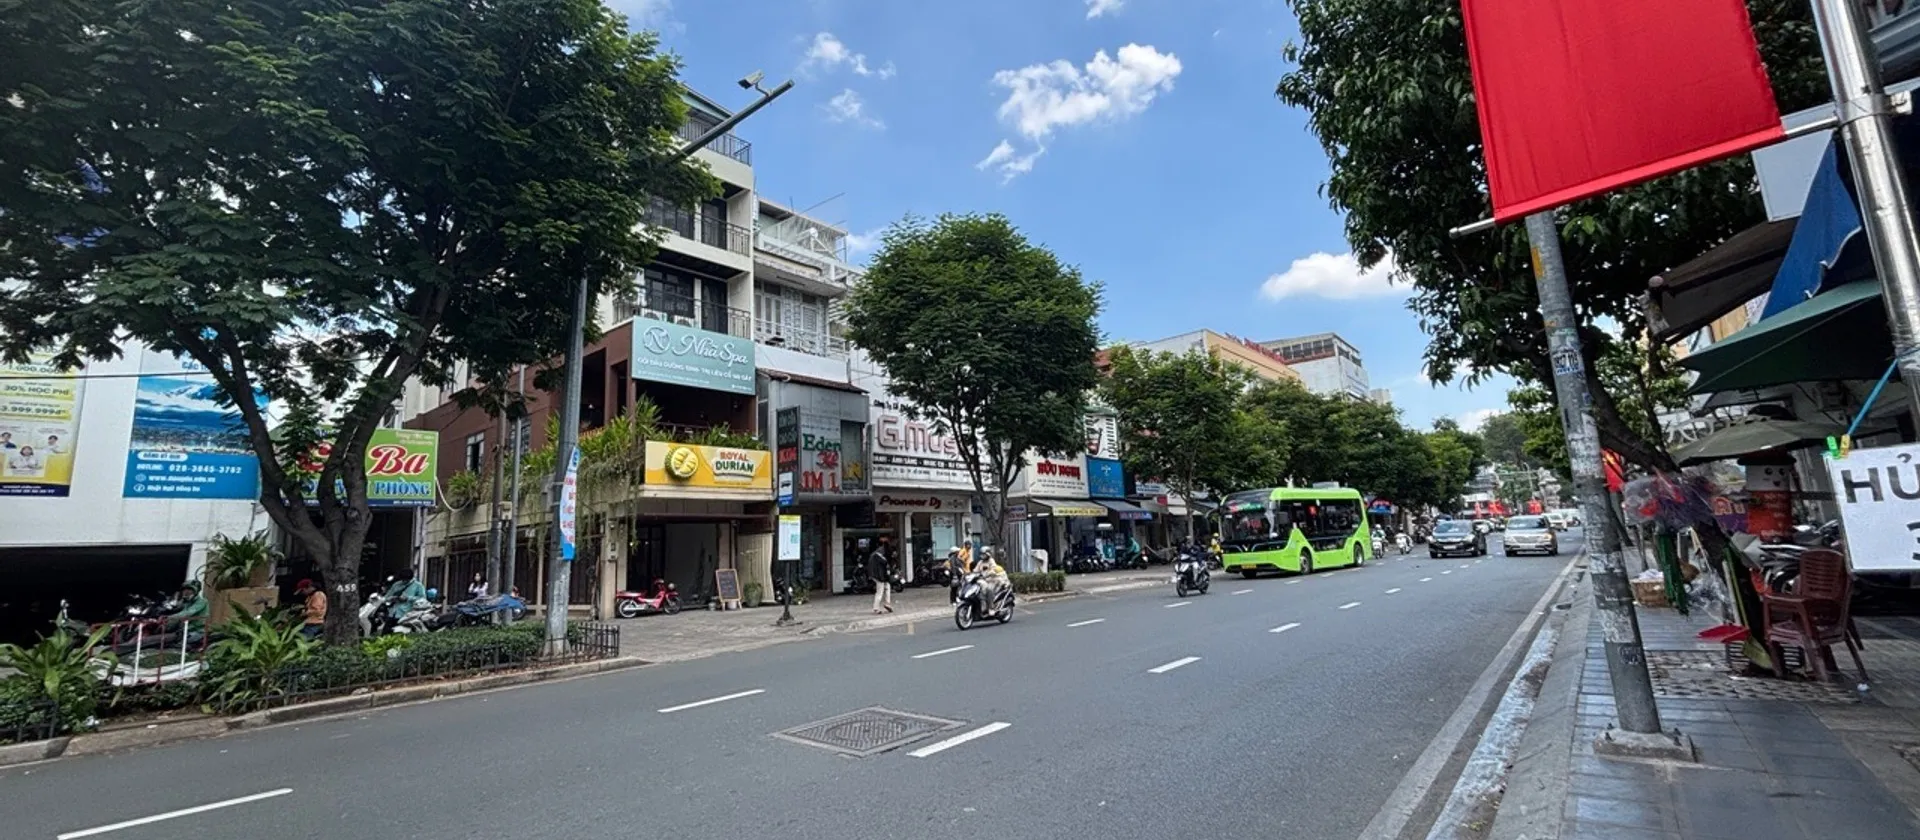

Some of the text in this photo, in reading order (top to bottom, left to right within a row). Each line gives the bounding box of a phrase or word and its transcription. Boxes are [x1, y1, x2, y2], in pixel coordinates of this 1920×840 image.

[719, 342, 749, 368] Spa
[368, 444, 429, 476] Ba
[720, 451, 749, 461] ROYAL
[715, 460, 755, 472] DURIAN
